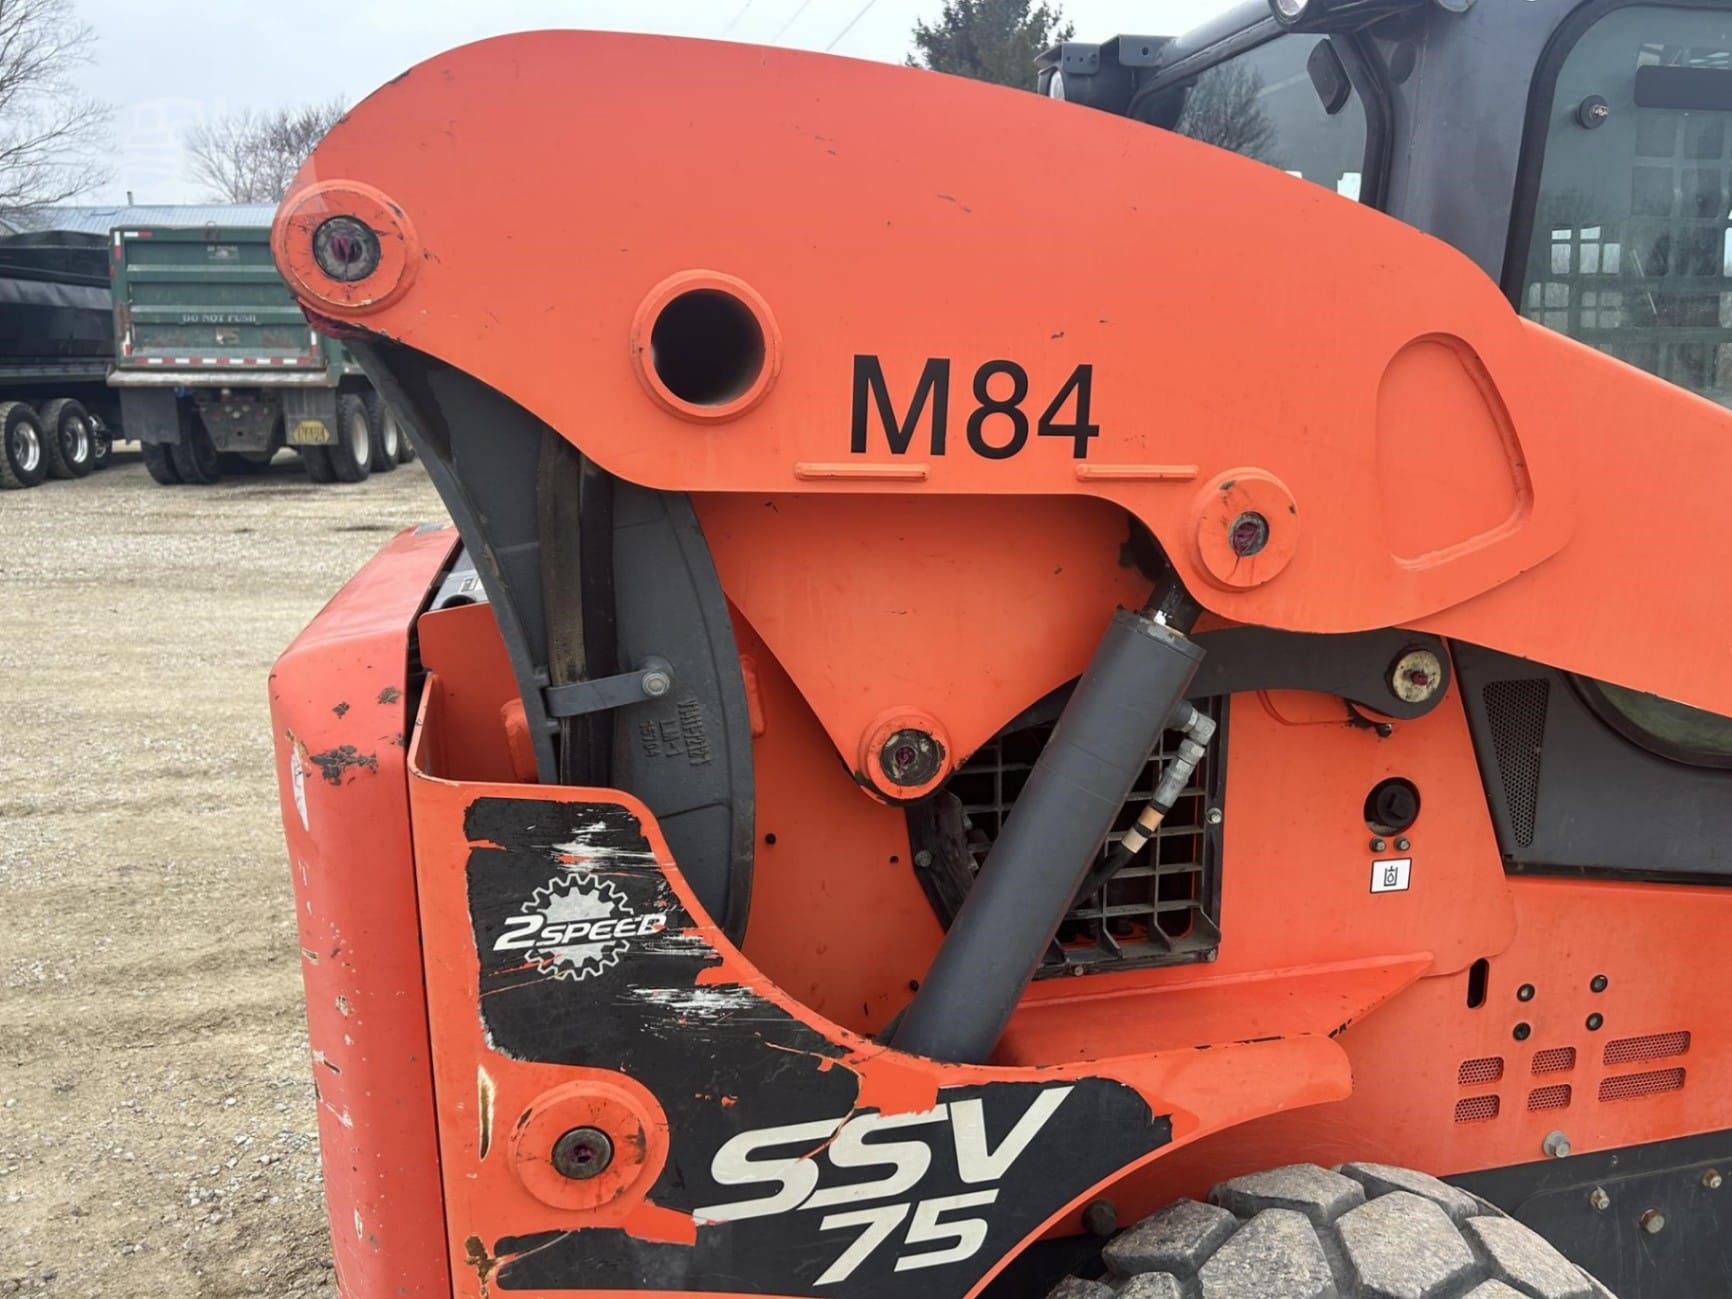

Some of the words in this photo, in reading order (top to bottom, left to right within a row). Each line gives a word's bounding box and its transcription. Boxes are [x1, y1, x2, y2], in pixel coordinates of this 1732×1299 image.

[201, 314, 225, 323] NOT
[851, 354, 1100, 460] M84
[692, 1085, 1075, 1226] SSV
[812, 1188, 999, 1287] 75
